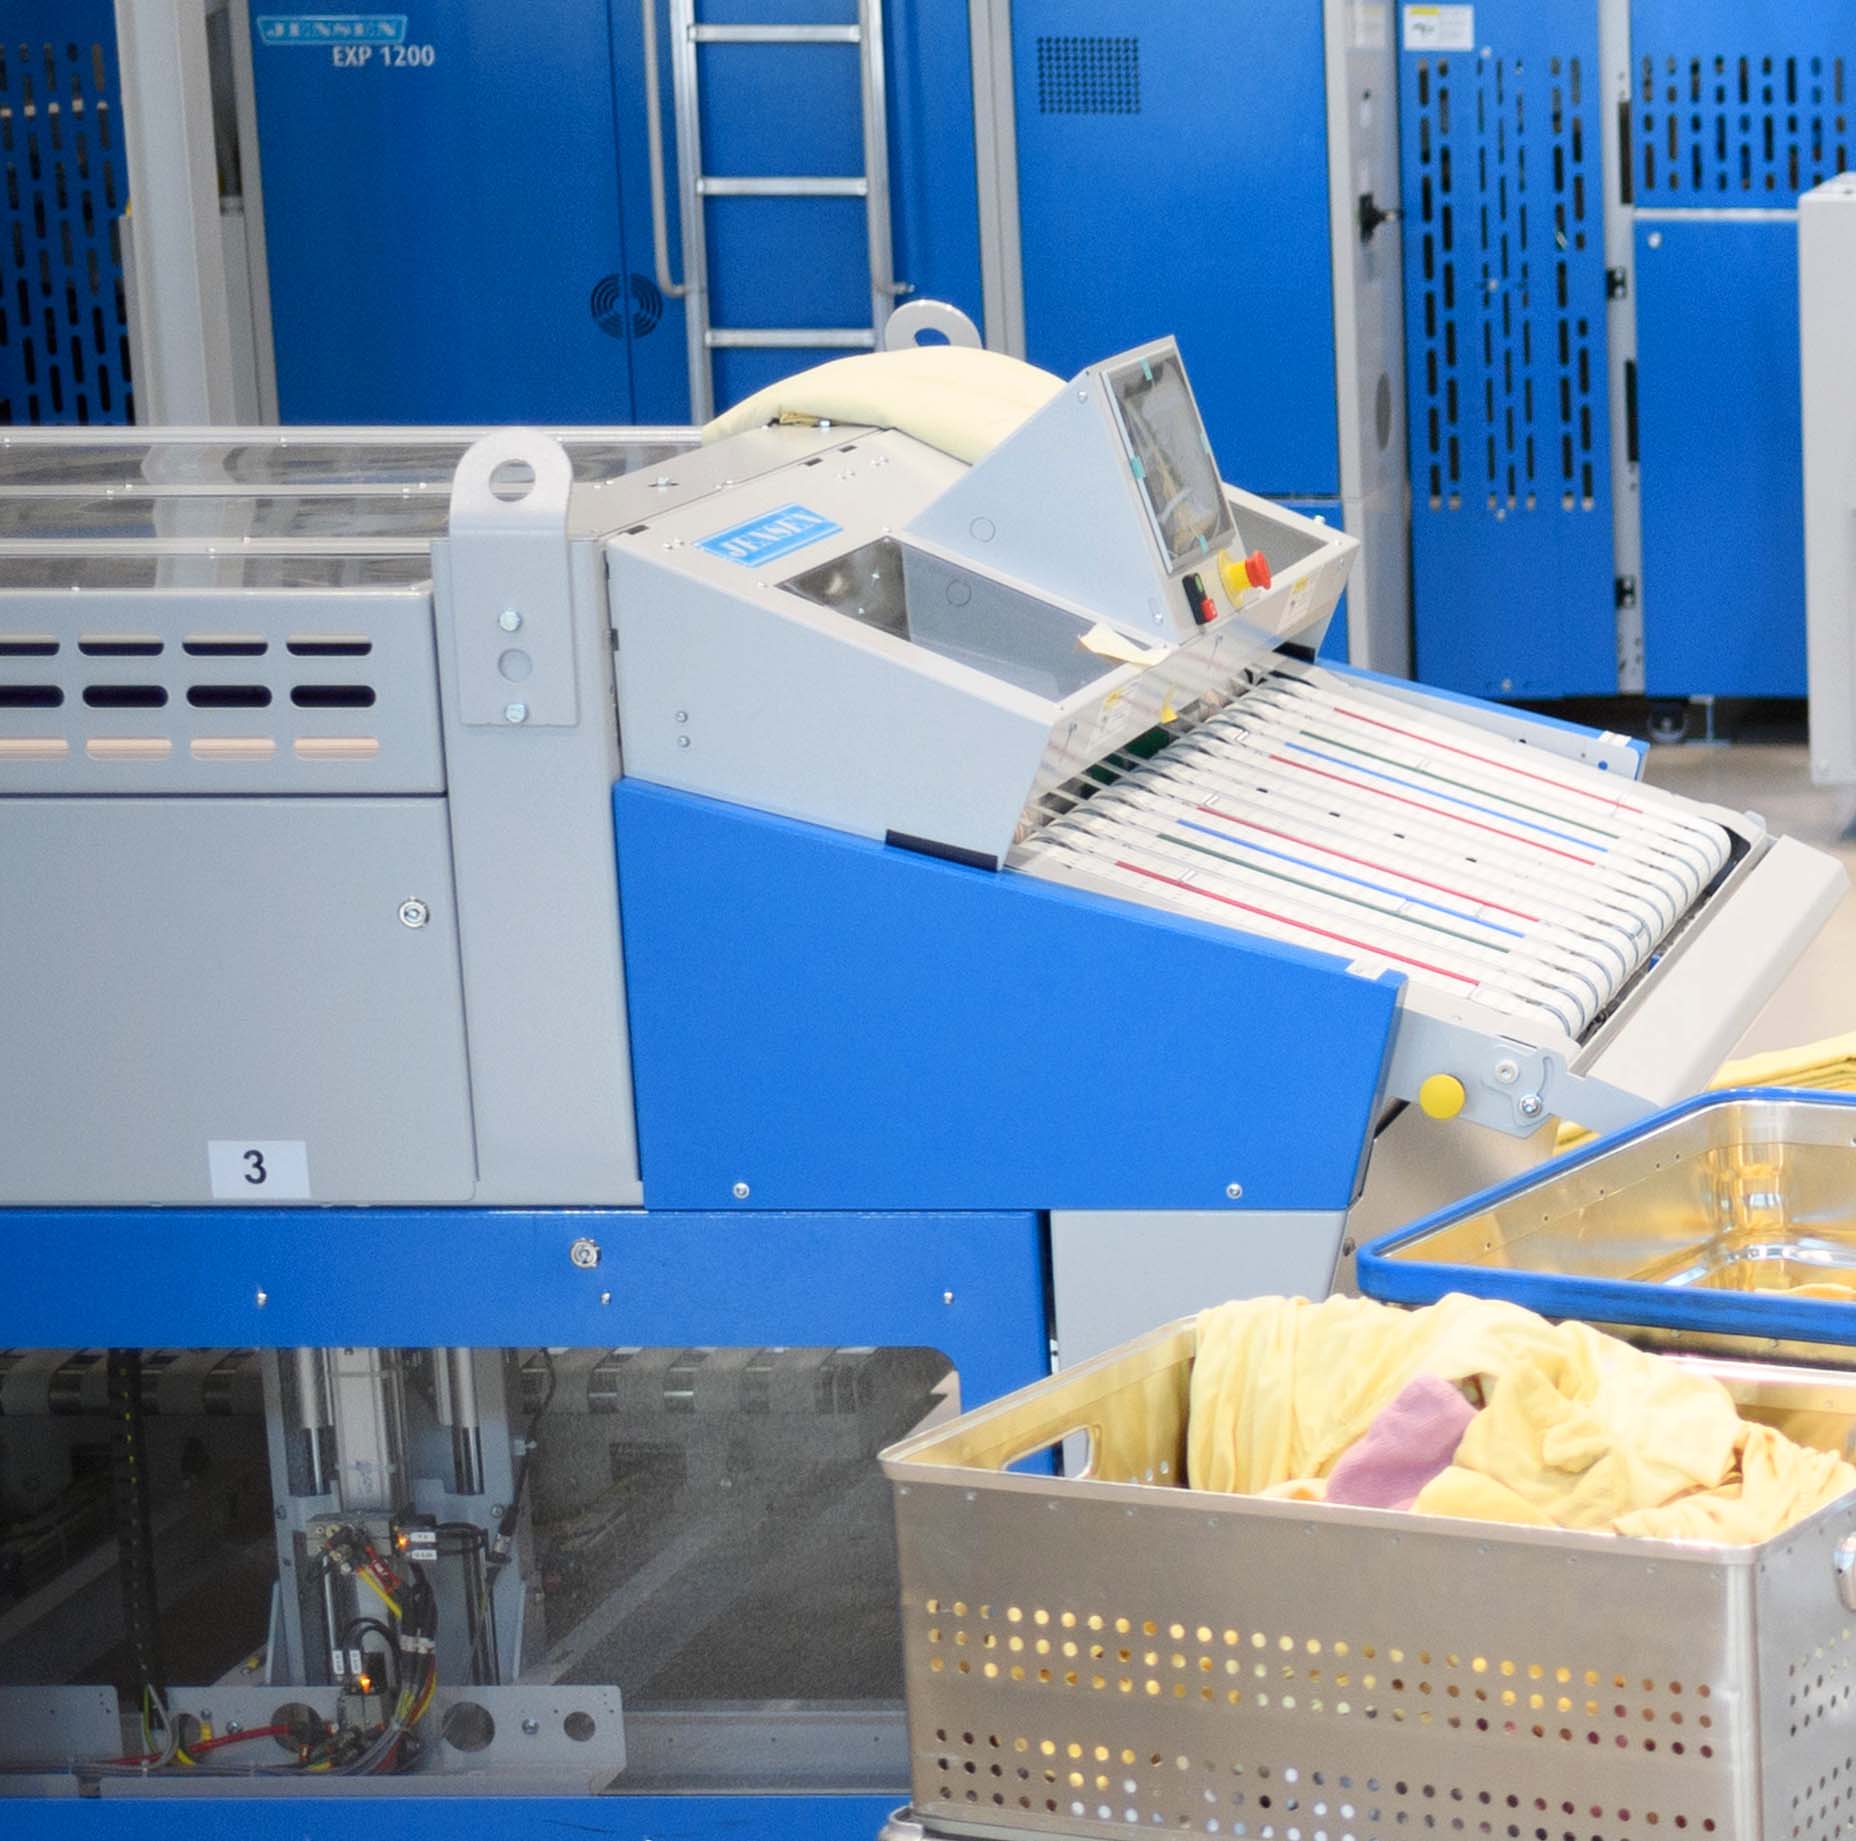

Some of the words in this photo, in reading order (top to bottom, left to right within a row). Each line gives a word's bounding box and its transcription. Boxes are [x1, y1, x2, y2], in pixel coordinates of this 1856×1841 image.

[266, 22, 397, 38] JENSEN
[332, 45, 373, 67] EXP
[380, 44, 436, 67] 1200
[721, 512, 824, 558] JENSEN
[243, 1149, 267, 1185] 3
